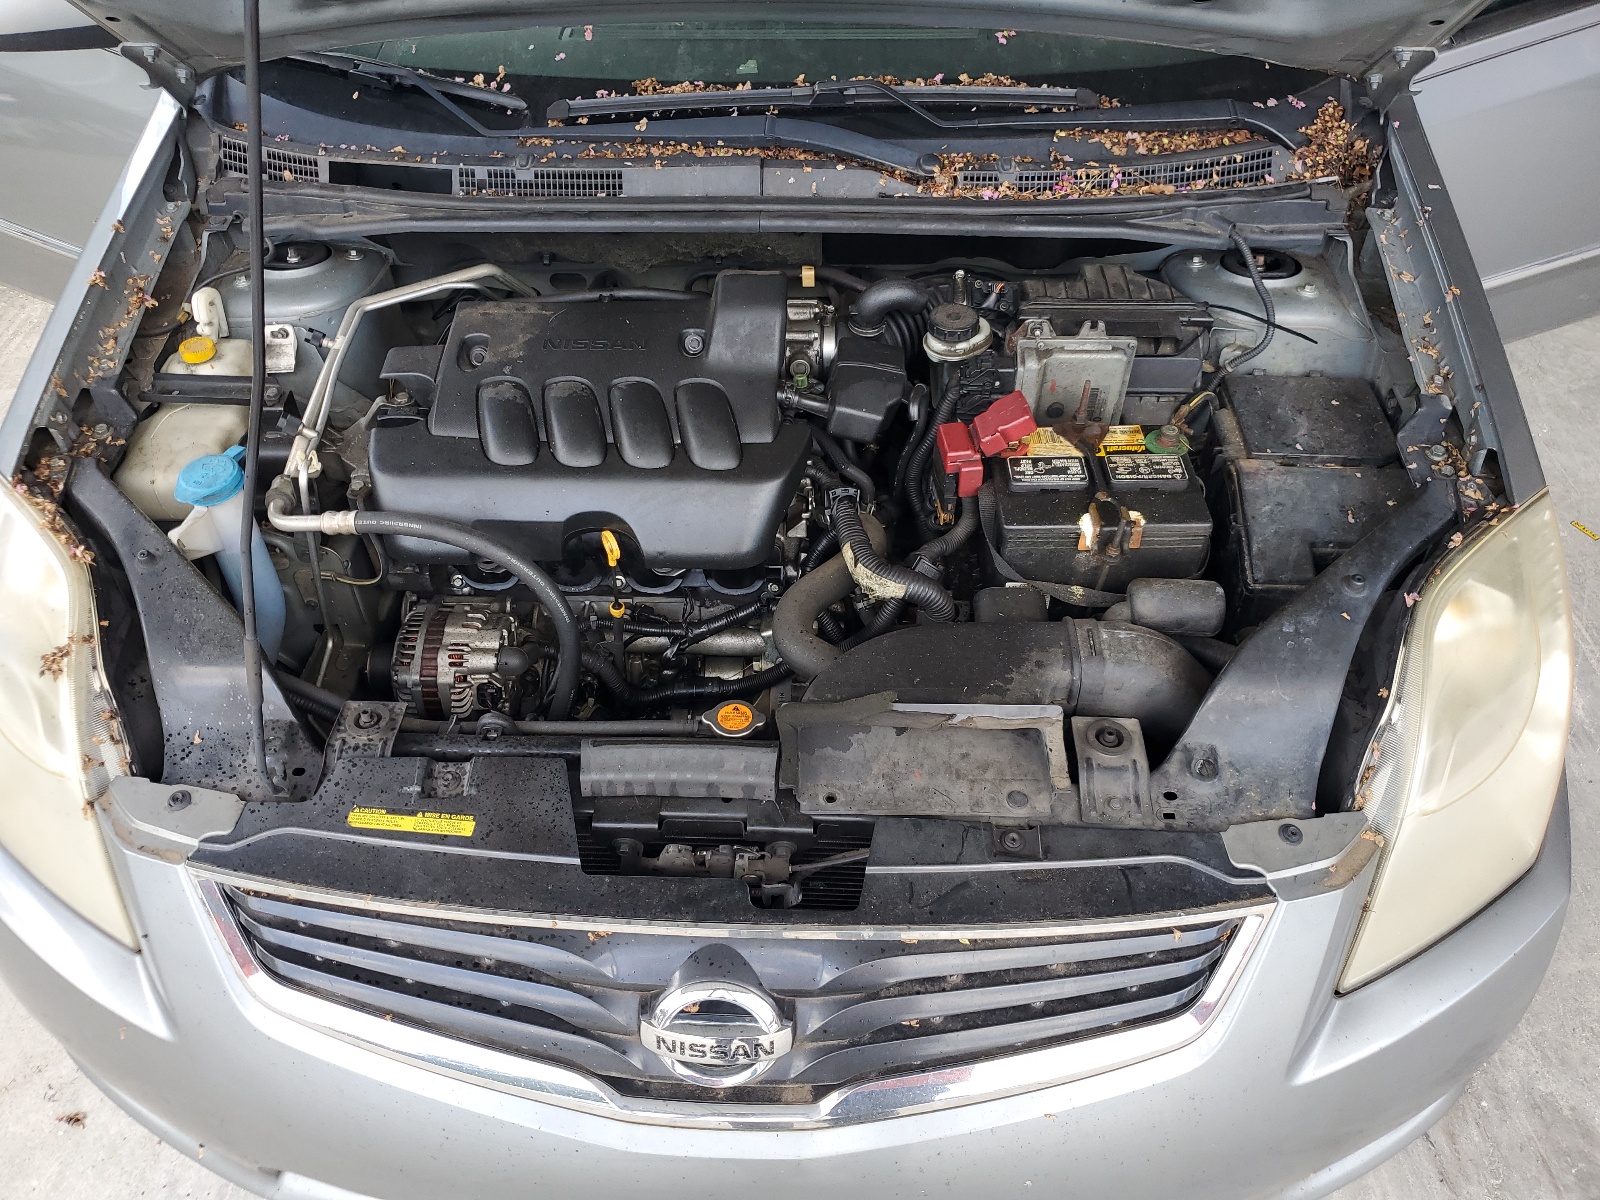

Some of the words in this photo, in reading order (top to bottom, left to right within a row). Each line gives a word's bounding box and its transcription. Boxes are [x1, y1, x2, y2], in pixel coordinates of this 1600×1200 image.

[542, 339, 647, 352] NISSAN
[451, 813, 475, 821] GARDE
[655, 1035, 775, 1060] NISSAN
